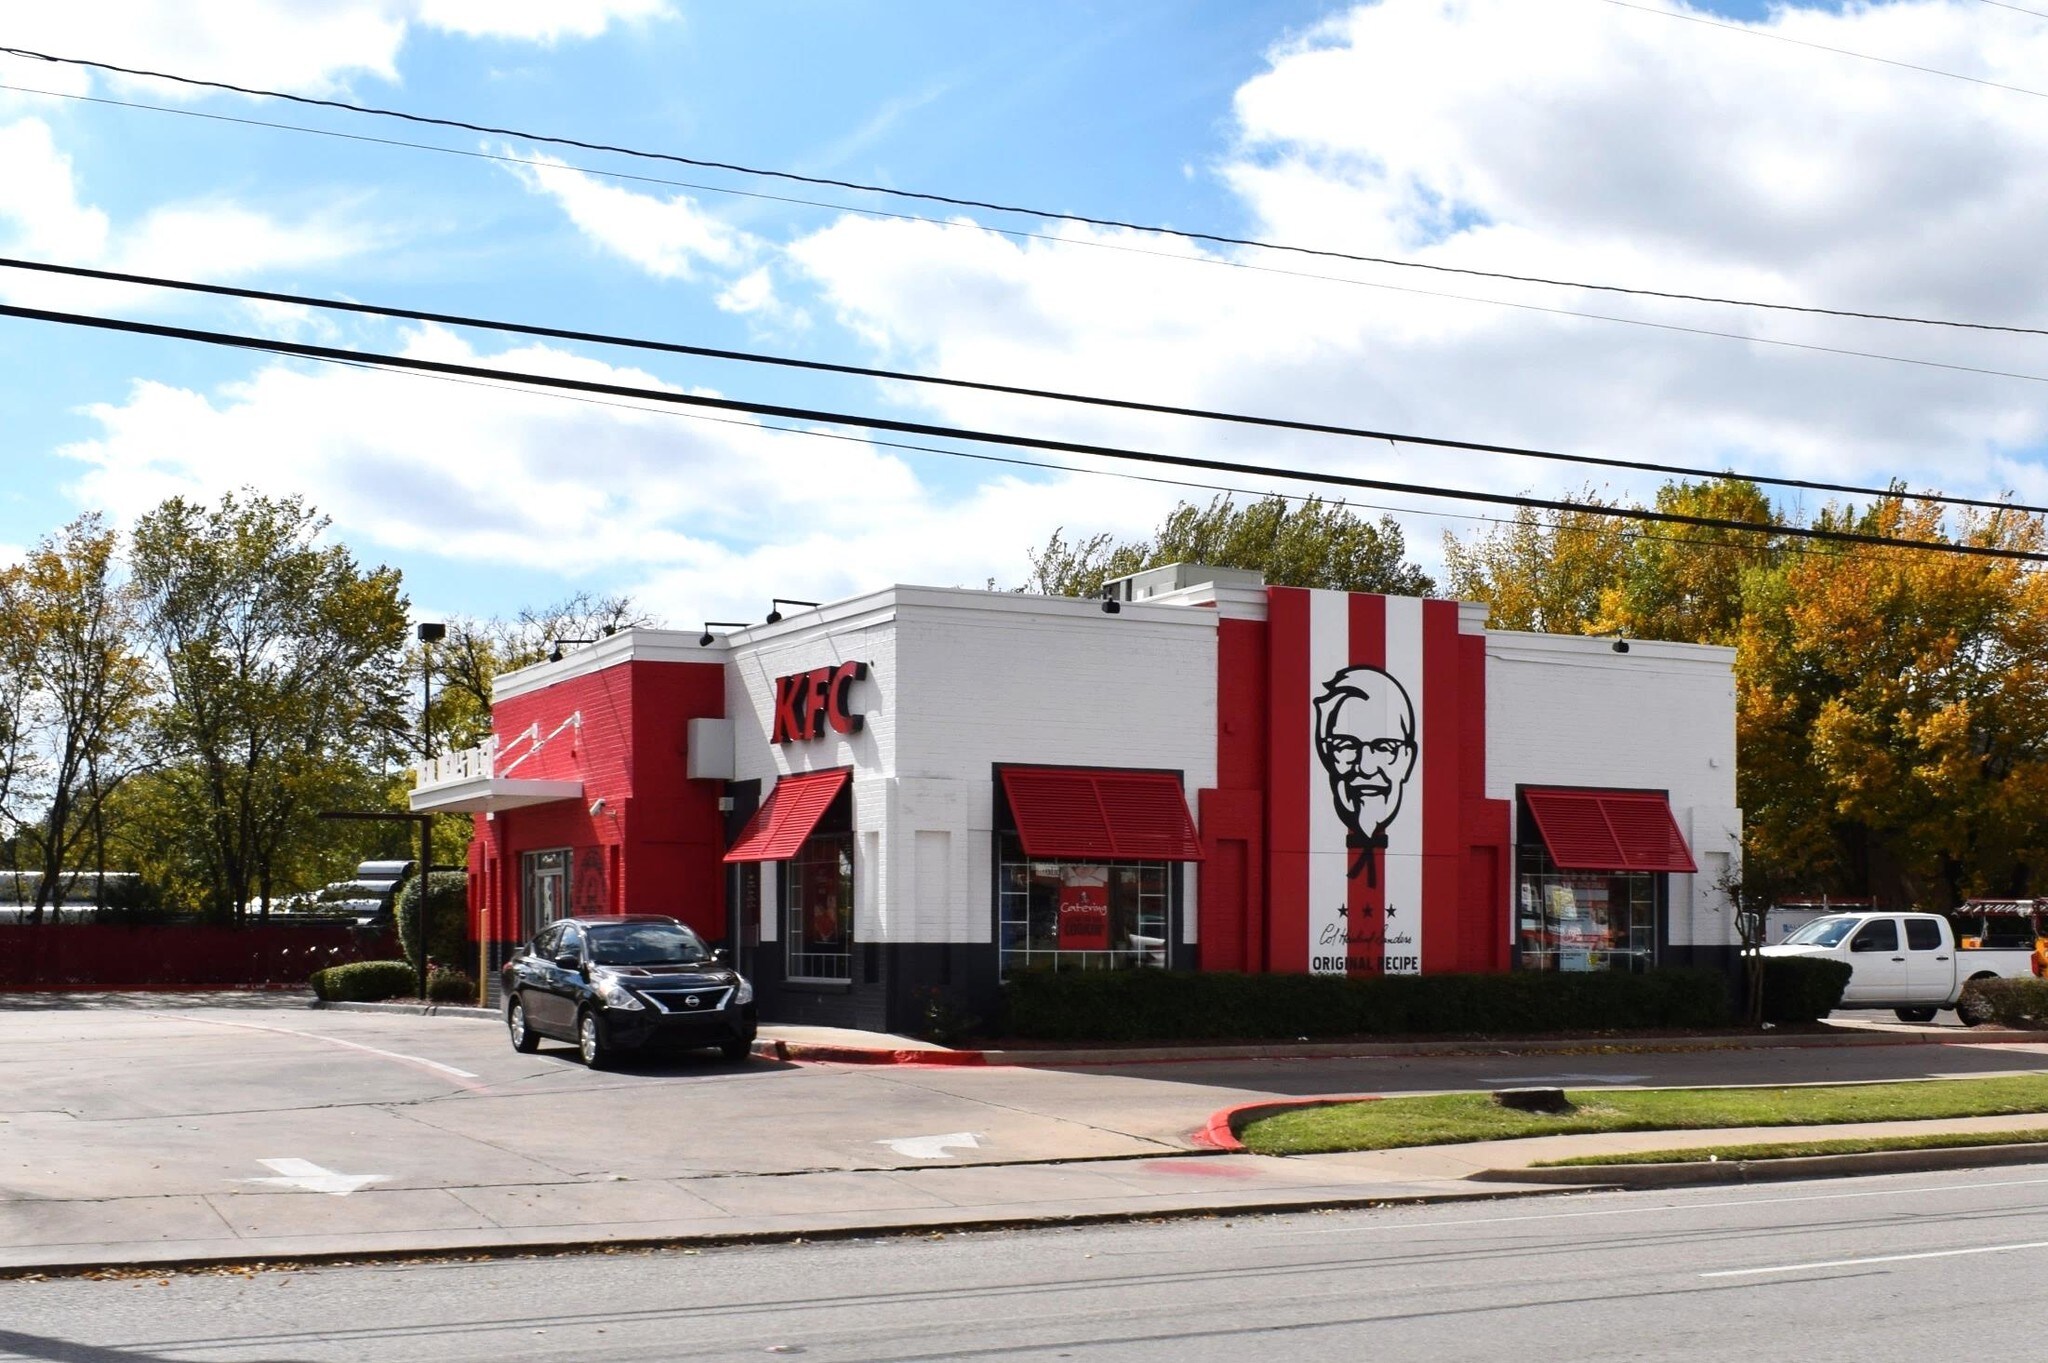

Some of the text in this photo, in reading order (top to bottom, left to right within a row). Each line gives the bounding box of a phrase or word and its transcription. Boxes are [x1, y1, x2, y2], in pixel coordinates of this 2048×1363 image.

[770, 660, 867, 744] KFC
[1060, 902, 1107, 916] Catering
[1319, 923, 1340, 945] Col
[1376, 923, 1413, 945] Sanders
[1312, 956, 1418, 971] ORIGINAL RECIPE
